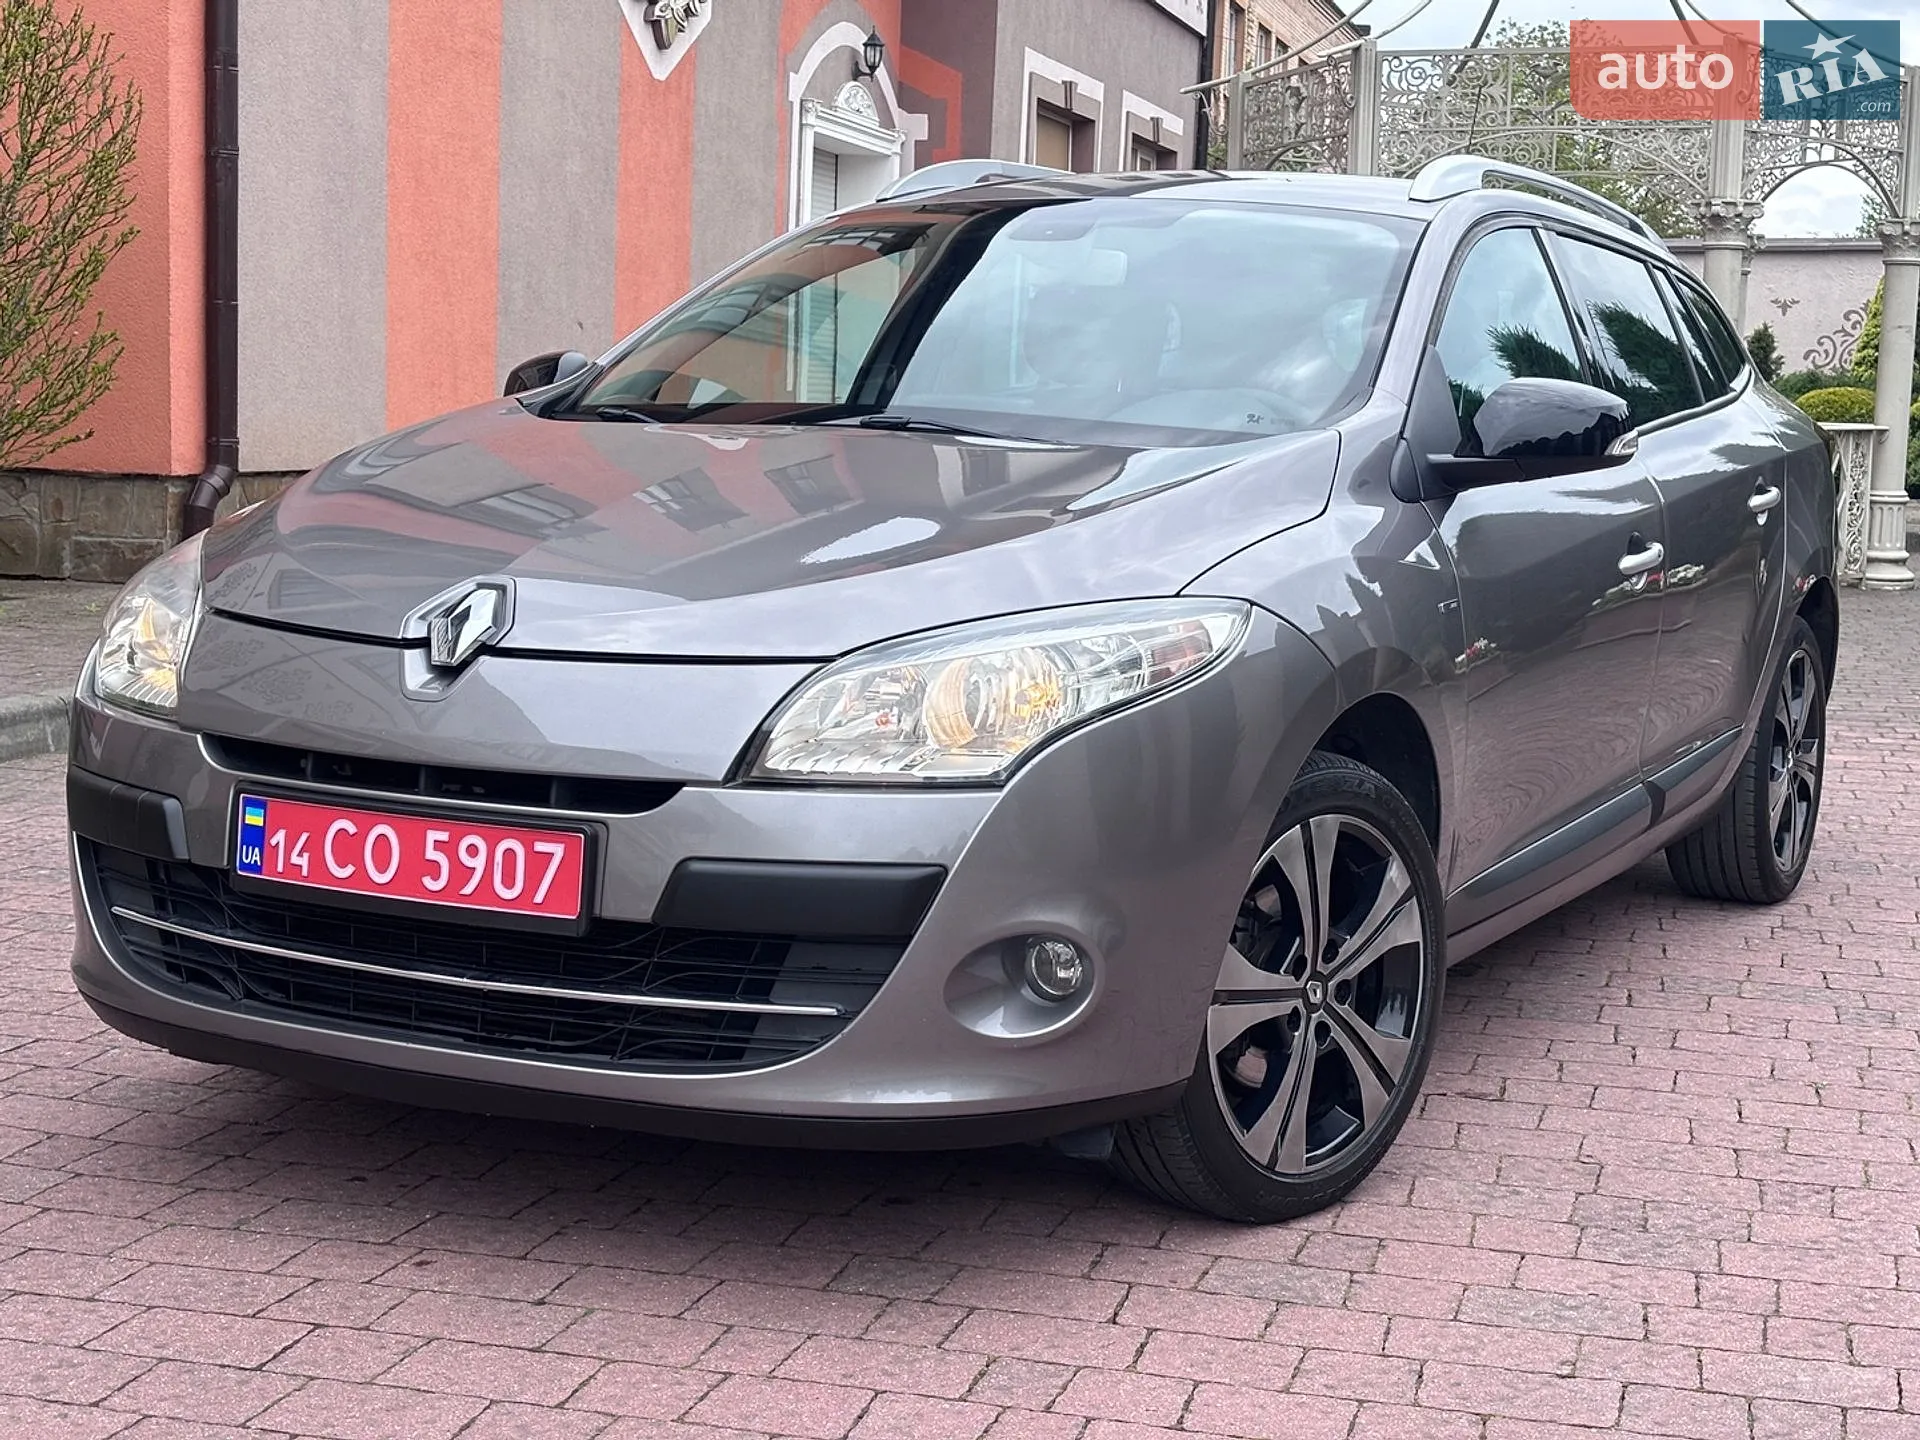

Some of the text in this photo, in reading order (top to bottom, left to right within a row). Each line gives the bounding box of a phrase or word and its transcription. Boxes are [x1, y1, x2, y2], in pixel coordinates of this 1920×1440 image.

[242, 845, 262, 866] UA
[269, 818, 566, 905] 14 CO 5907
